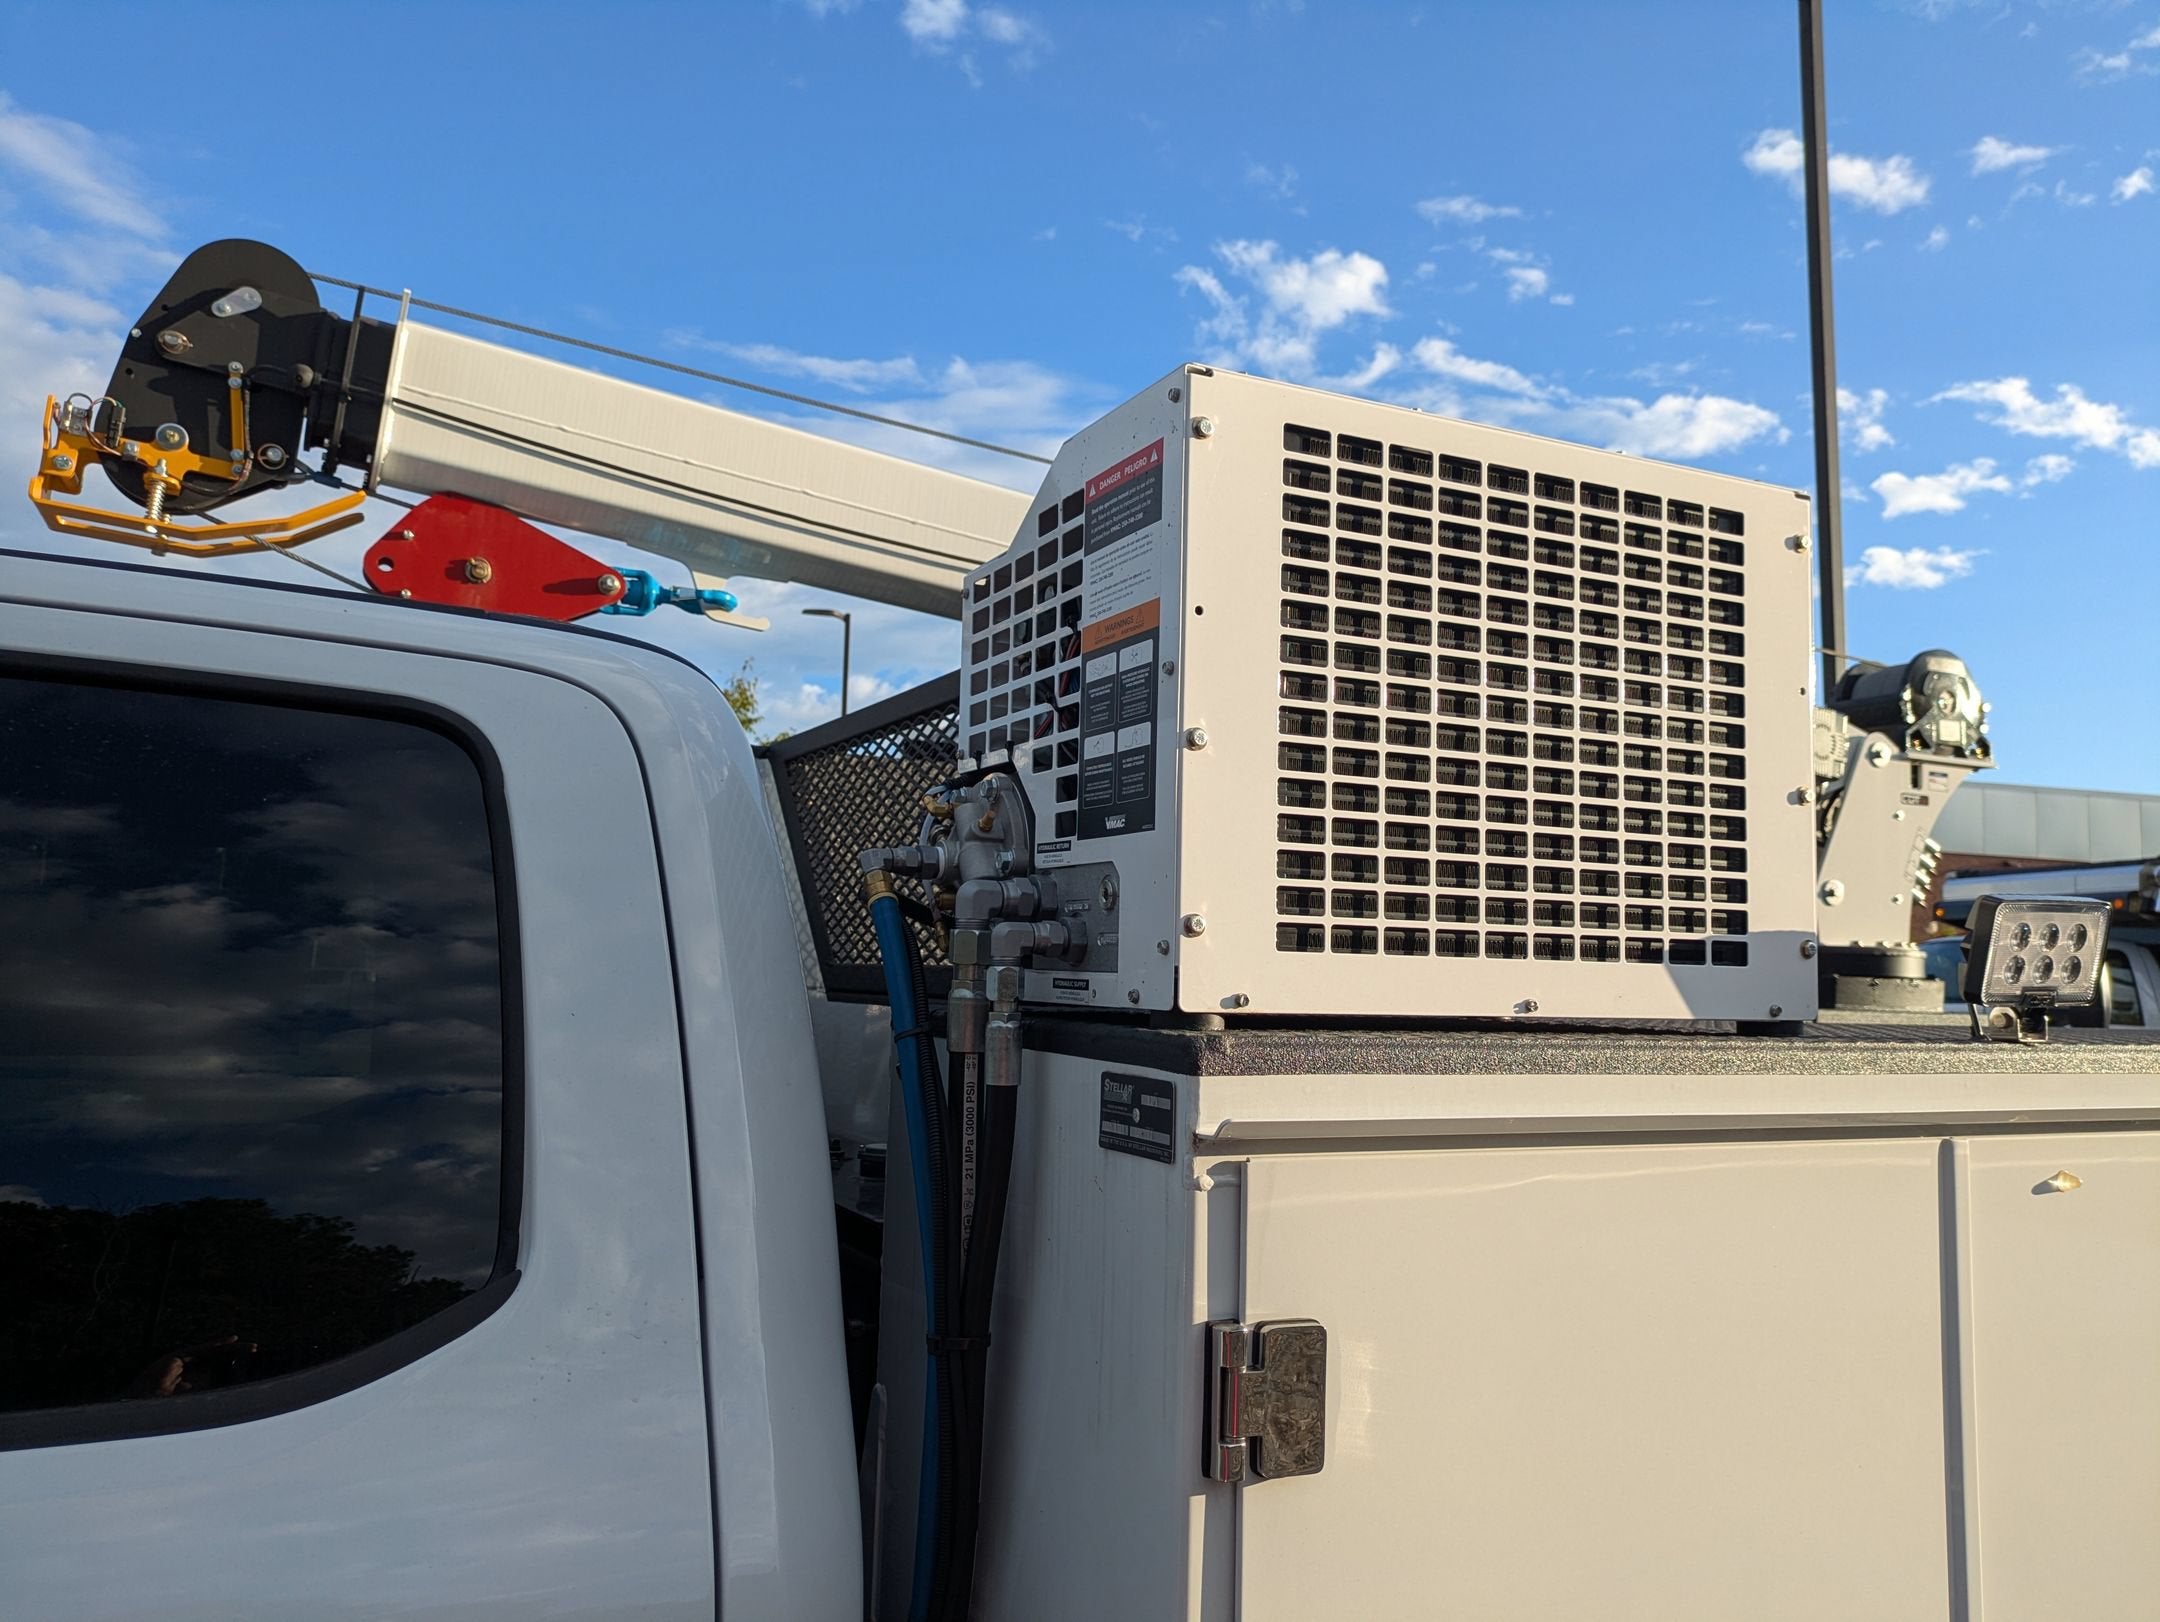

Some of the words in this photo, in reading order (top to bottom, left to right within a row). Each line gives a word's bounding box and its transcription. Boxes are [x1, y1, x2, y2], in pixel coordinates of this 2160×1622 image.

[1100, 471, 1121, 490] DANGER
[1124, 457, 1148, 476] PELIGRO
[1104, 616, 1134, 633] WARNINGS
[1105, 816, 1126, 830] VMAC
[965, 1081, 976, 1104] PSI)
[1104, 1078, 1133, 1094] STELLAR
[964, 1106, 975, 1136] (3000
[965, 1139, 974, 1163] MPa
[965, 1167, 974, 1180] 21
